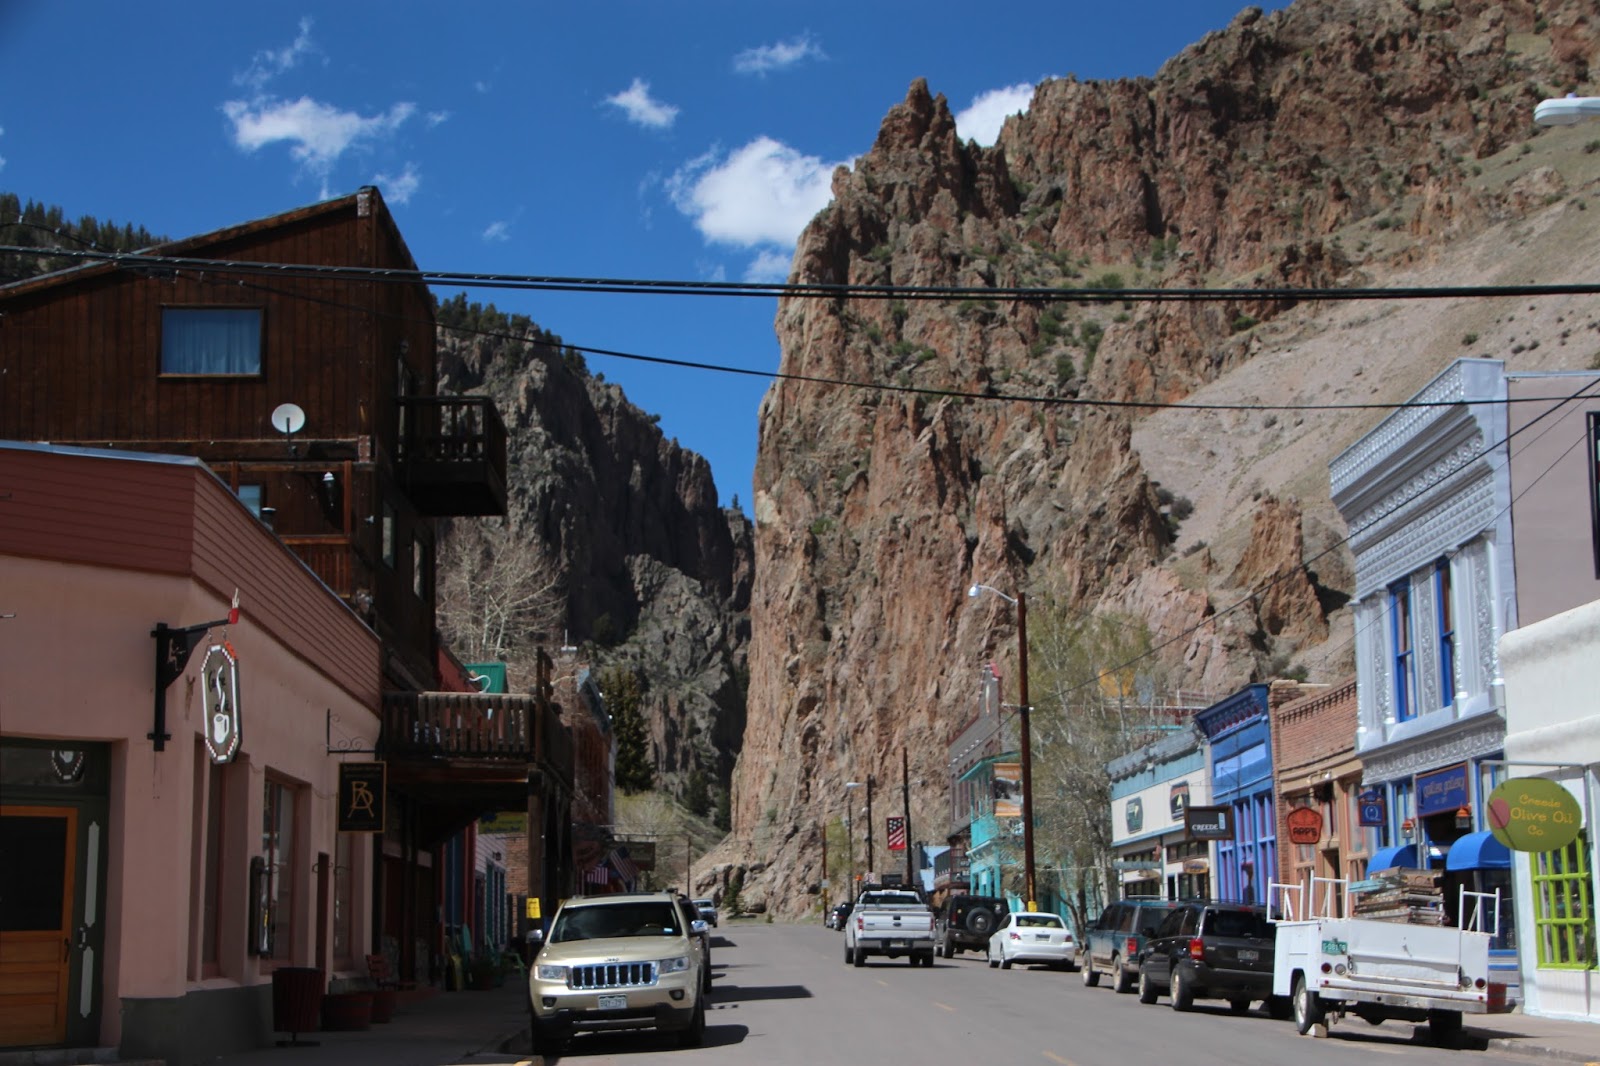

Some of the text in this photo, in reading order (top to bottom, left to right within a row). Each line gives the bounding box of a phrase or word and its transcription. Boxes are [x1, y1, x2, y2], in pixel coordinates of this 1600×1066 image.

[1519, 793, 1562, 808] Creede
[1510, 807, 1574, 824] Olive Oil
[1191, 823, 1219, 831] CREEDE
[1527, 824, 1544, 836] Co
